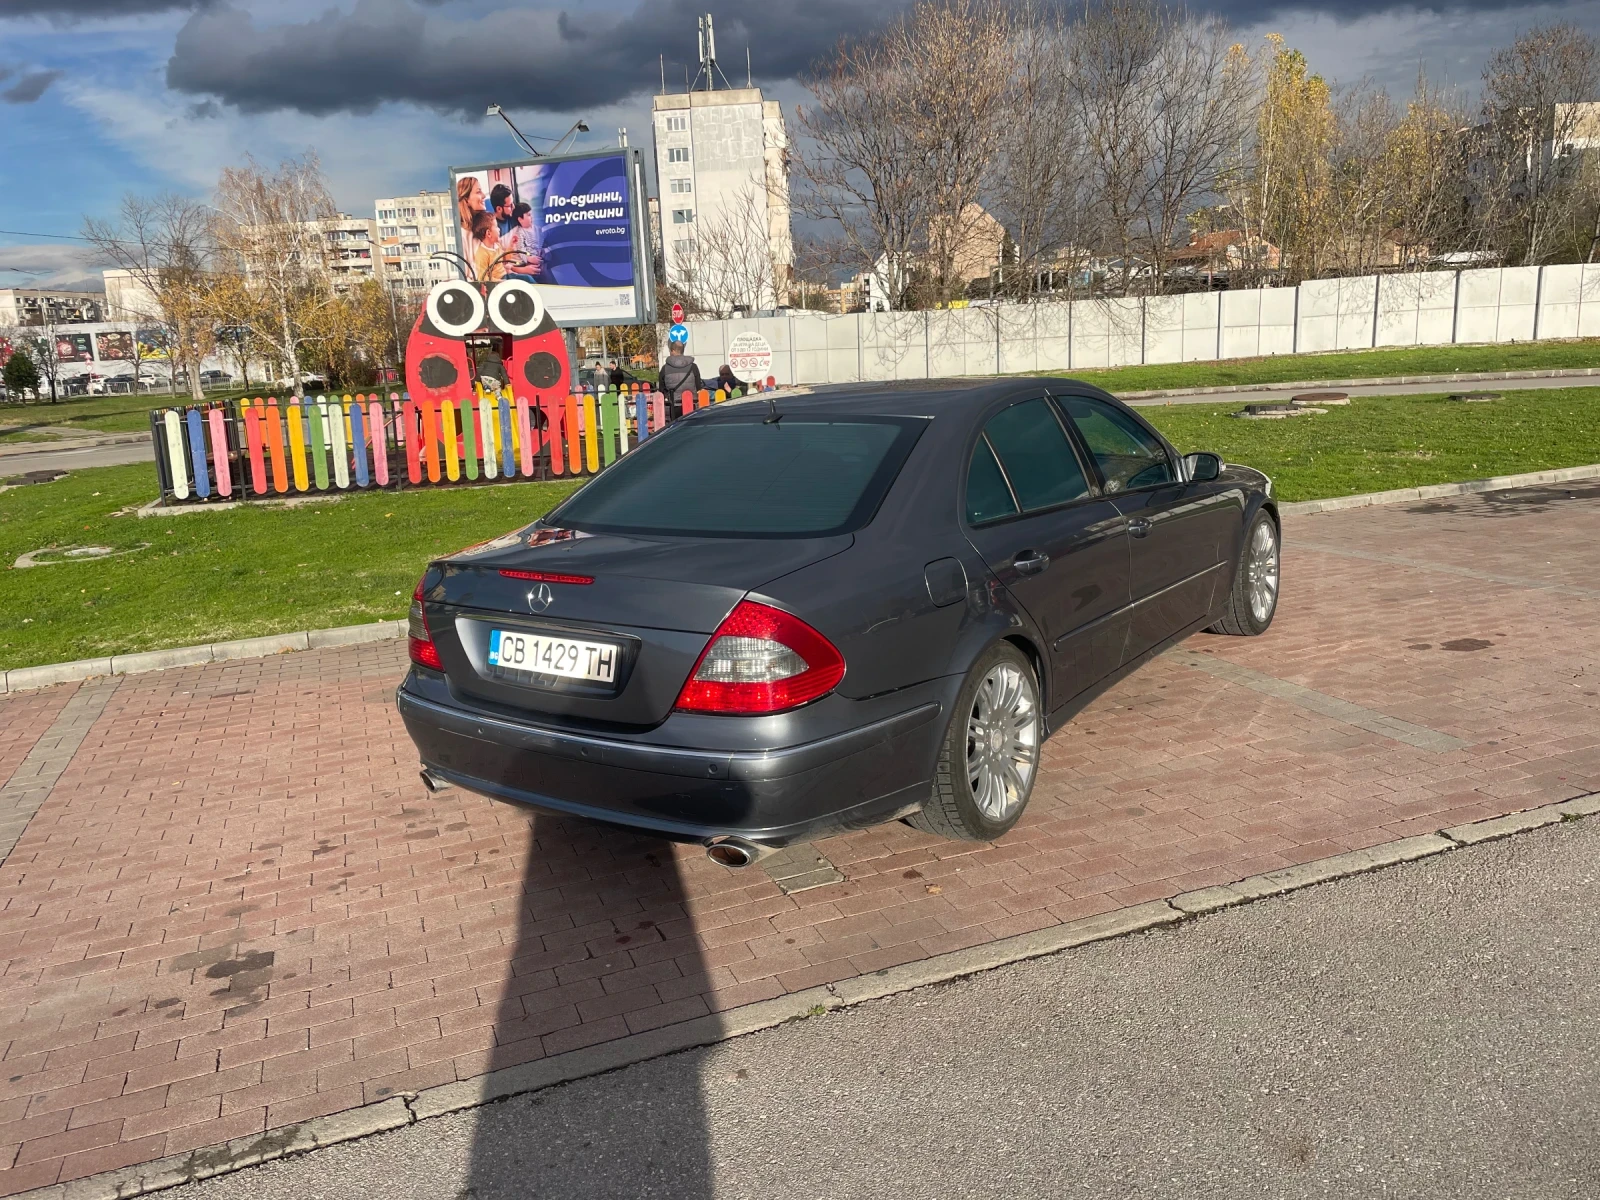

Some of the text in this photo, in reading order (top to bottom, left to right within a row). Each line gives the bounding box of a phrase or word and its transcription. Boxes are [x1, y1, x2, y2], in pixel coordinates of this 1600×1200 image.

[549, 191, 623, 208] По-единни,
[545, 207, 624, 225] по-успешни
[595, 226, 625, 235] evroto.bg
[672, 310, 684, 318] STOP
[502, 636, 526, 664] CB
[533, 640, 579, 672] 1429
[585, 646, 613, 678] TH
